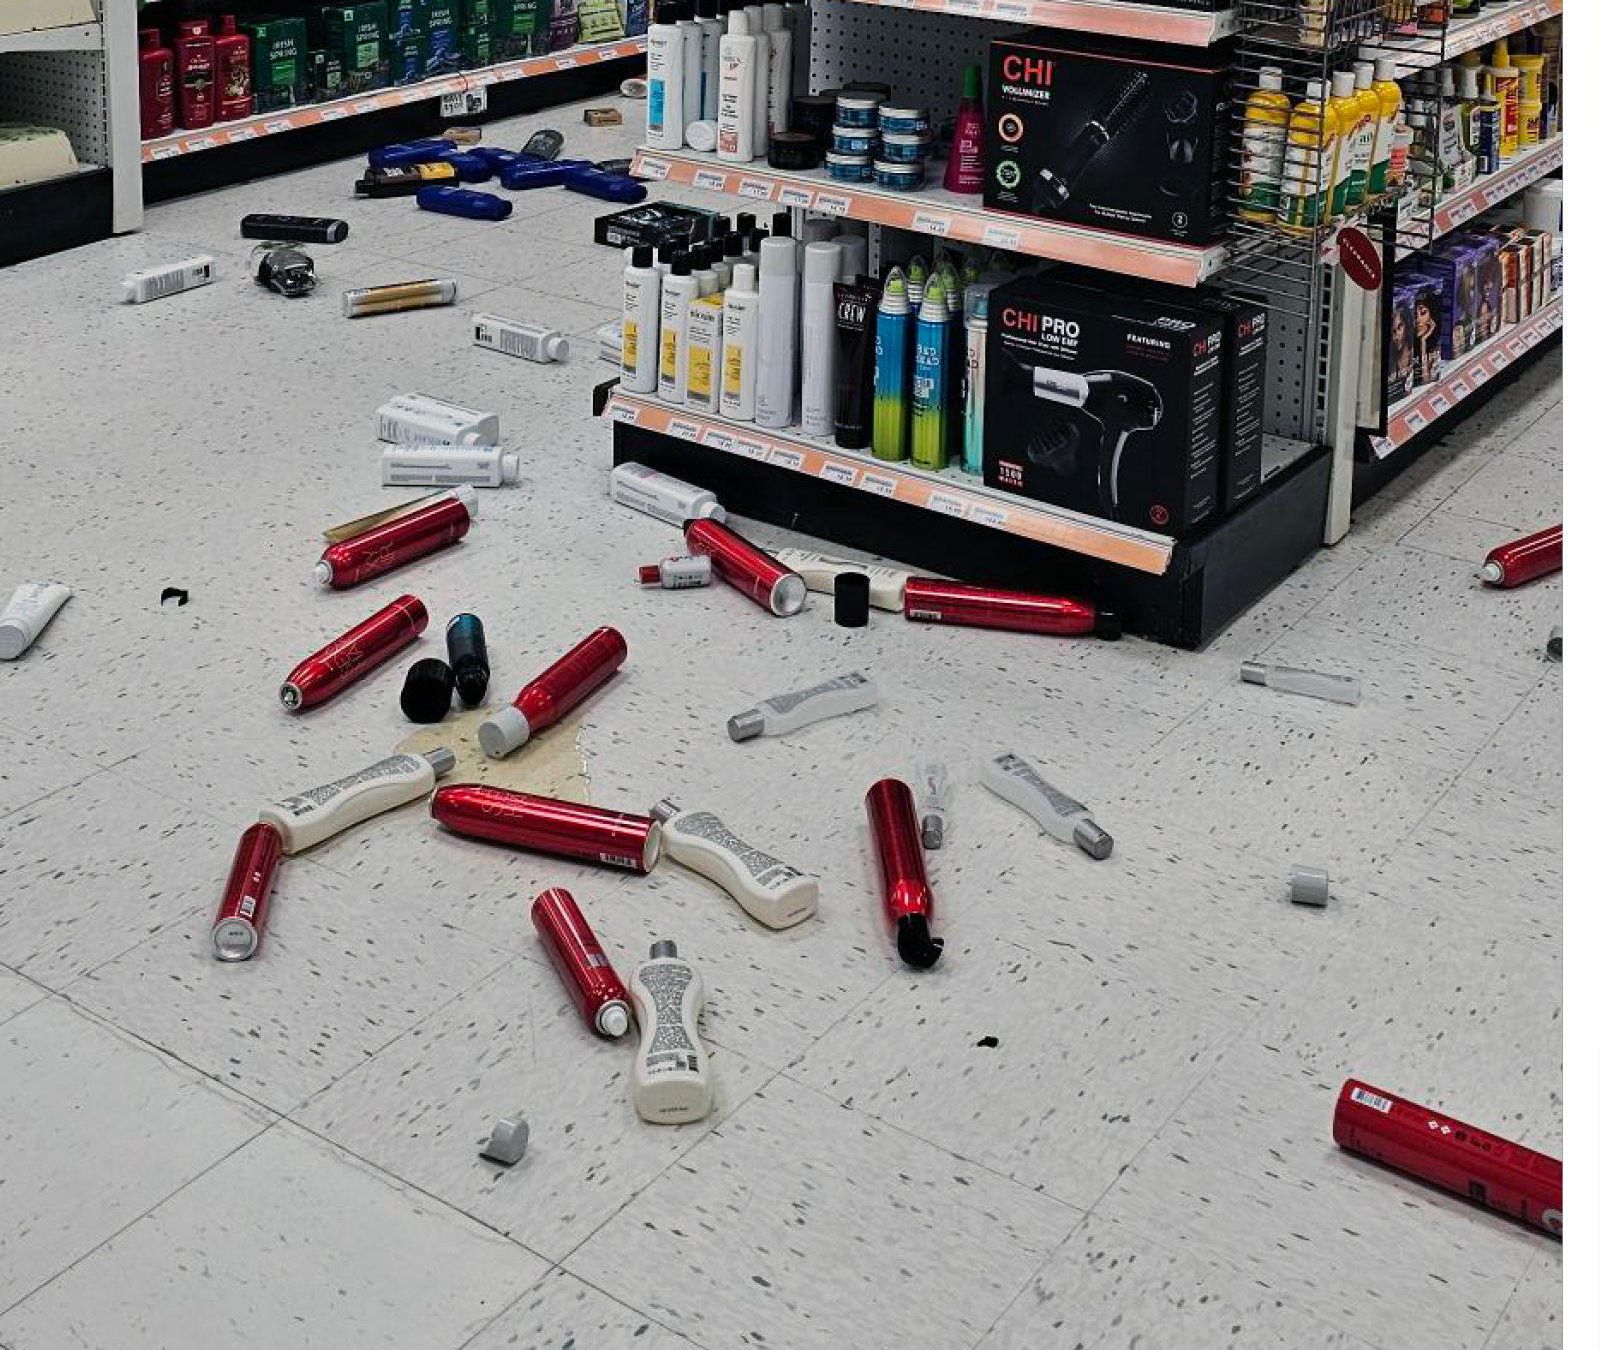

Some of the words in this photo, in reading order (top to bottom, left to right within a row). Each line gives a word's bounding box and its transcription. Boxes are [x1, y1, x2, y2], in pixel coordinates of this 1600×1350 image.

[1003, 54, 1053, 85] CHI
[838, 303, 866, 322] CREW
[1002, 308, 1038, 332] CHI
[1041, 314, 1080, 338] PRO
[1126, 333, 1171, 349] FEATURING
